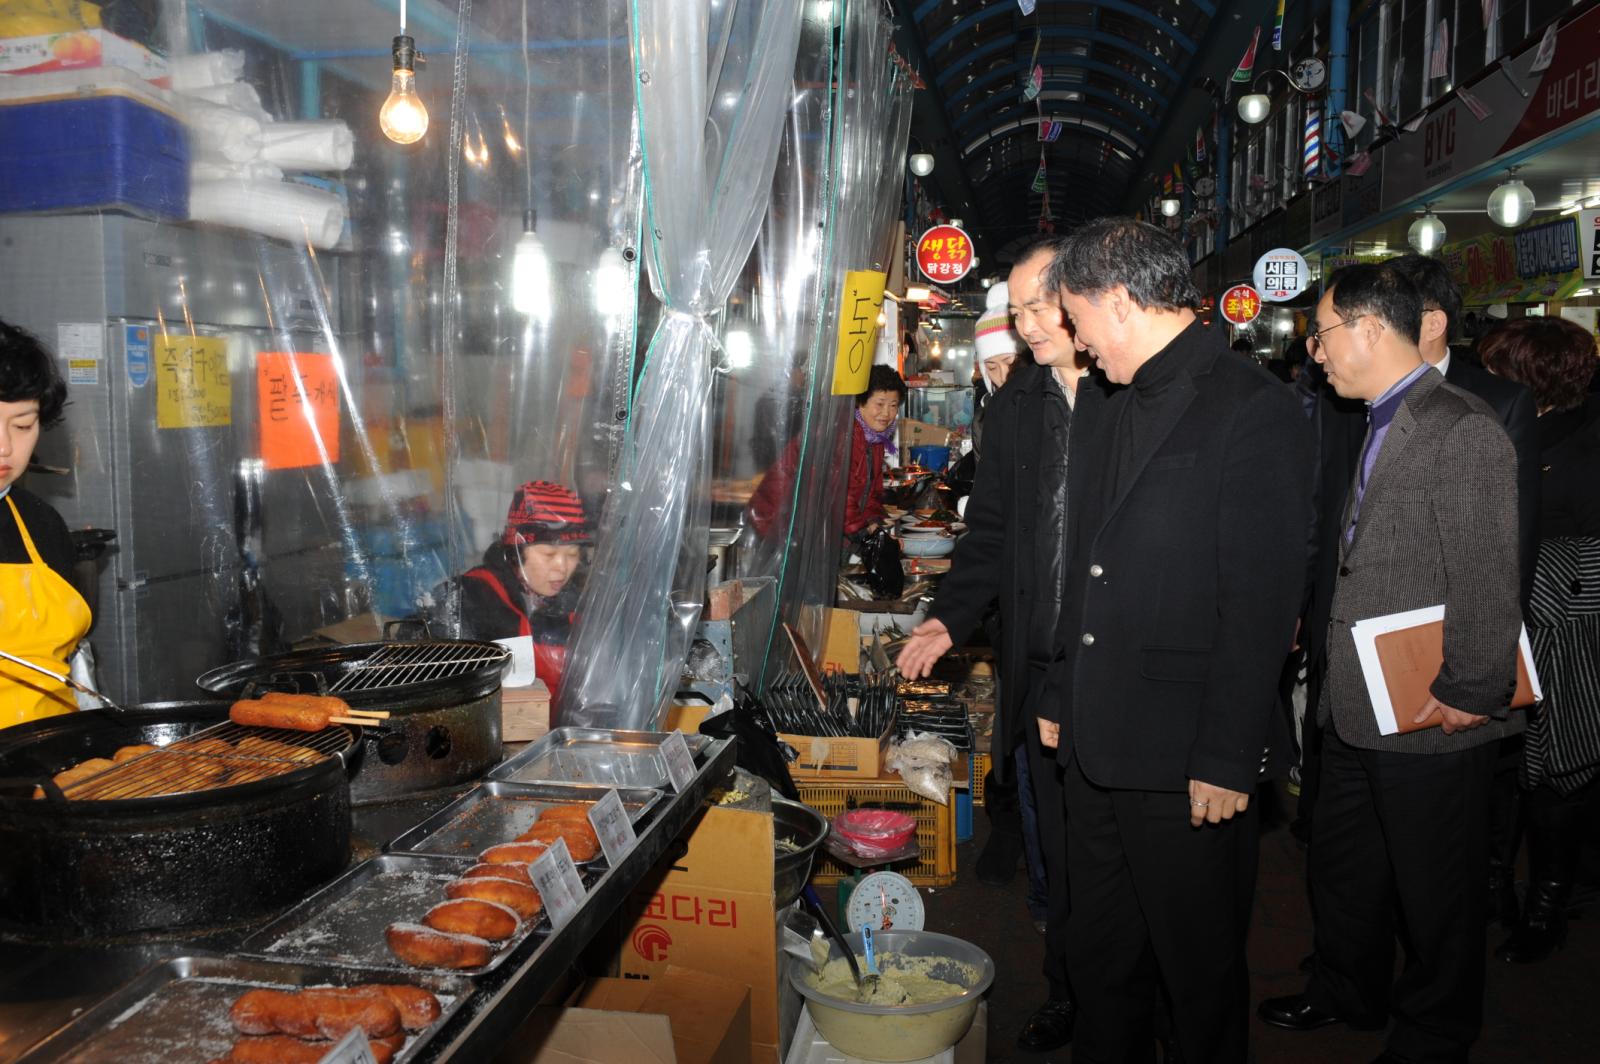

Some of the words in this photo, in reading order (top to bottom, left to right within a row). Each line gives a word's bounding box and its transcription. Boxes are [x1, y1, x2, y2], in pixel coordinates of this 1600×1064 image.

[1424, 108, 1456, 168] BYC
[921, 236, 967, 260] 생닭
[927, 263, 963, 275] 닭강정
[1265, 262, 1297, 275] 서울
[1265, 277, 1297, 290] 의류
[1227, 298, 1256, 318] 족발
[640, 892, 737, 929] 코다리
